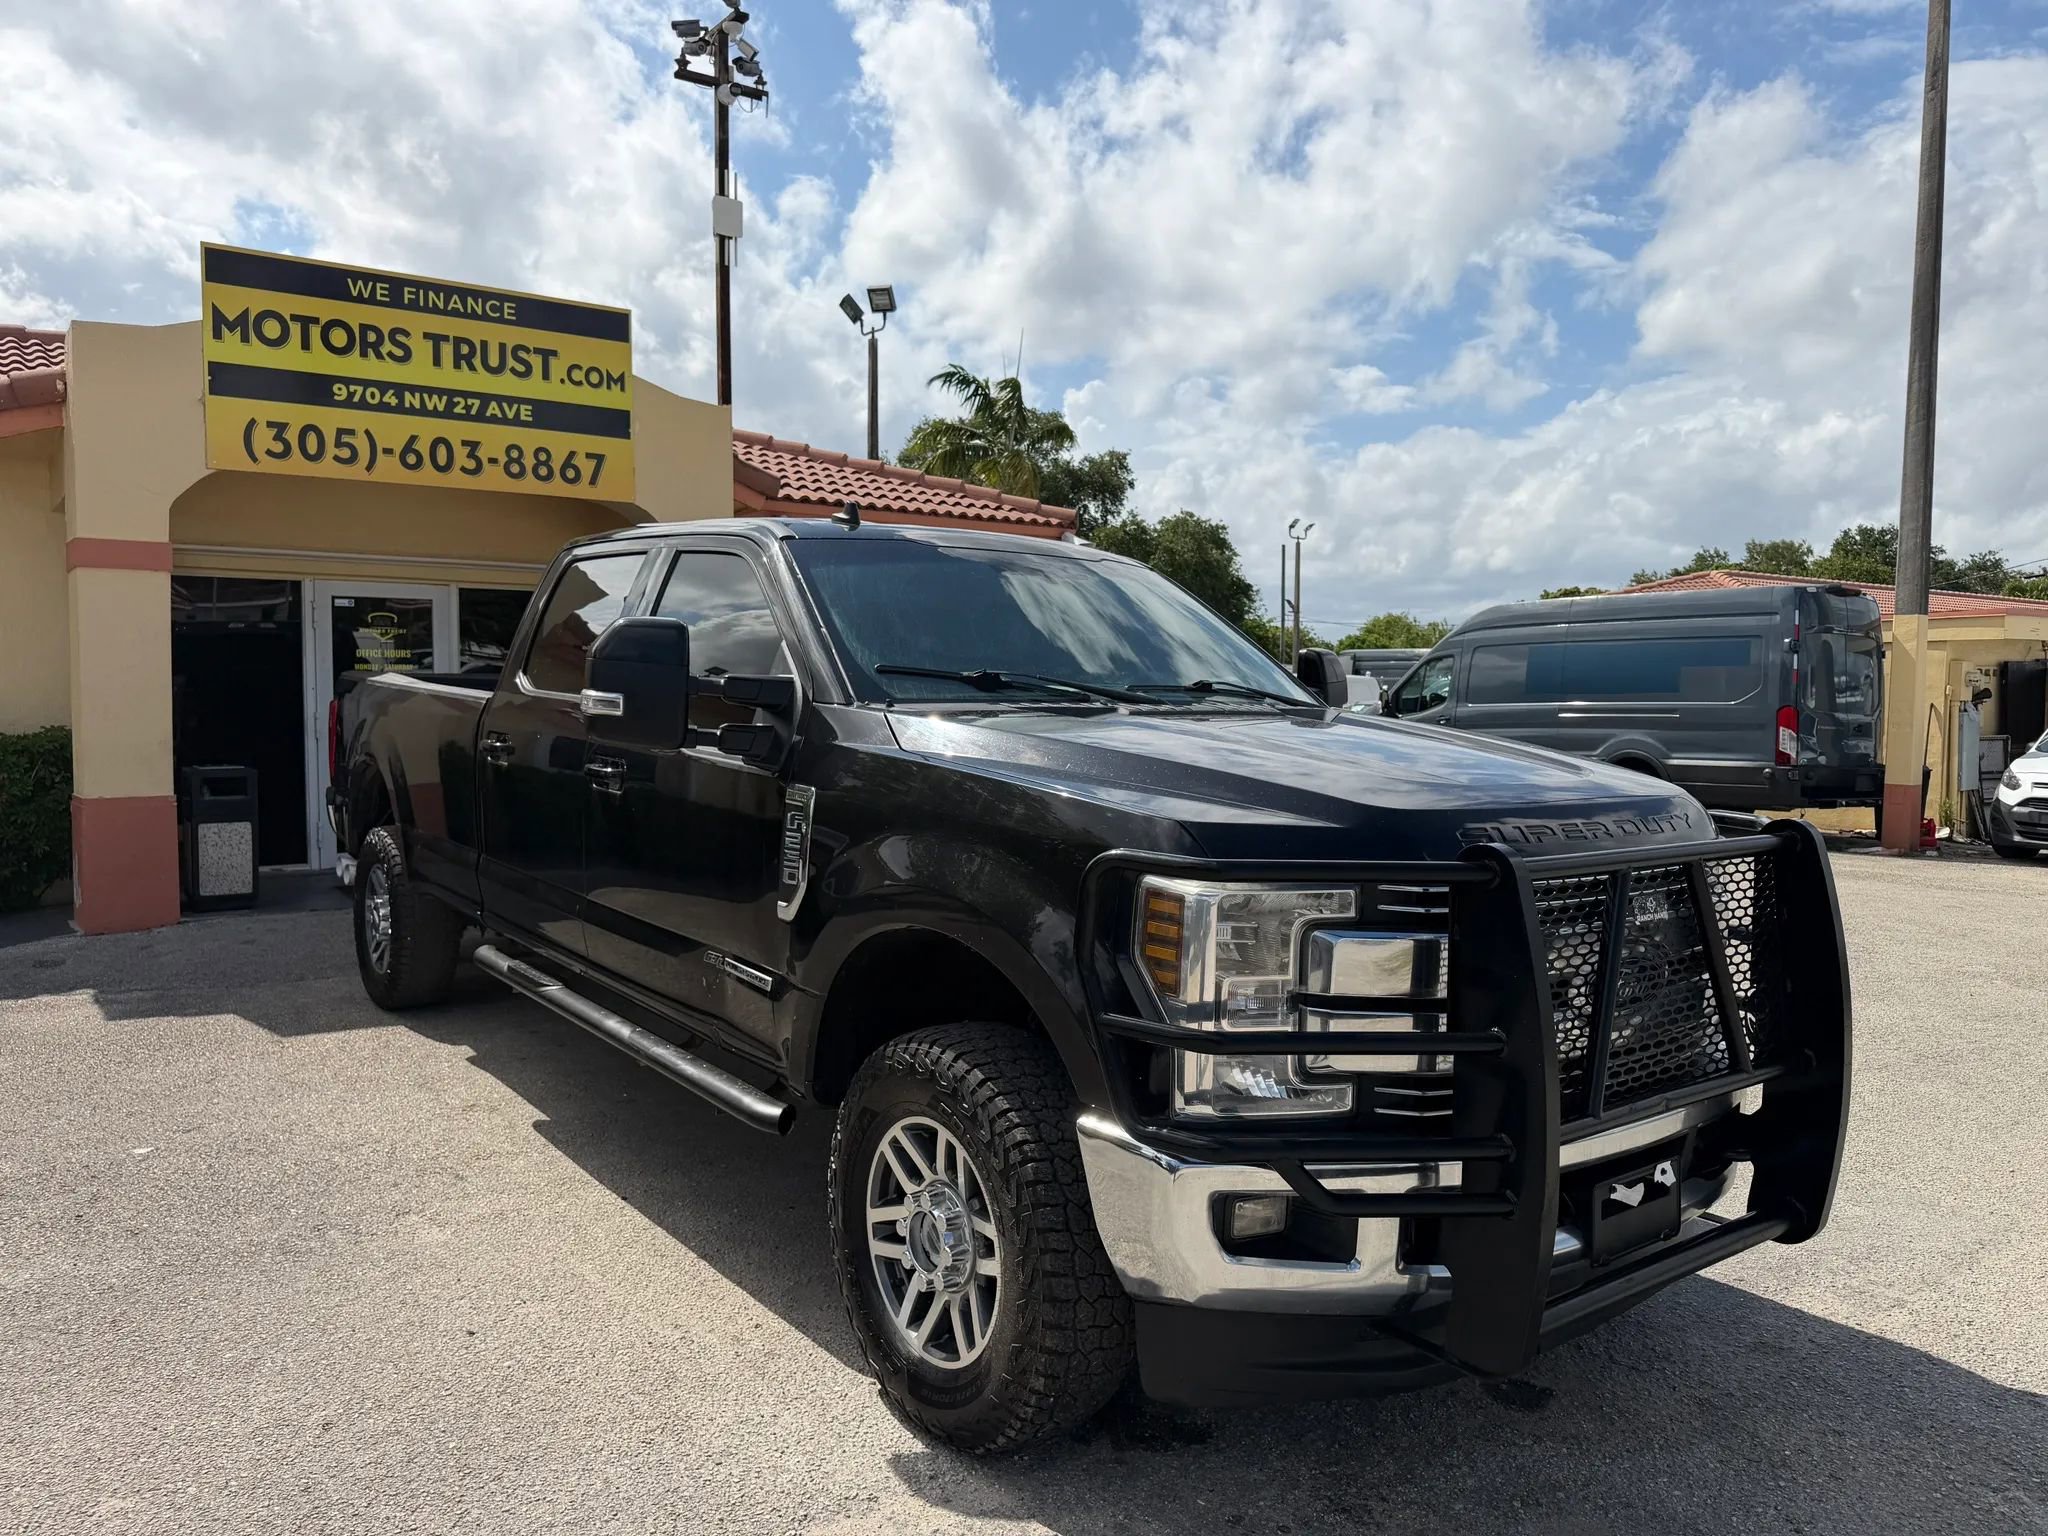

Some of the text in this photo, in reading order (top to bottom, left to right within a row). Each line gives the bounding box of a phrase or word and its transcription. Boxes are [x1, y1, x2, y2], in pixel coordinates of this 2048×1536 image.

[346, 277, 517, 320] WE FINANCE
[211, 302, 414, 366] MOTORS
[332, 382, 534, 422] 9704 NW 27 AVE
[243, 416, 608, 489] (305)-603-8867
[356, 649, 411, 658] OFFICE HOURS
[1456, 812, 1692, 846] SUPER DUTY
